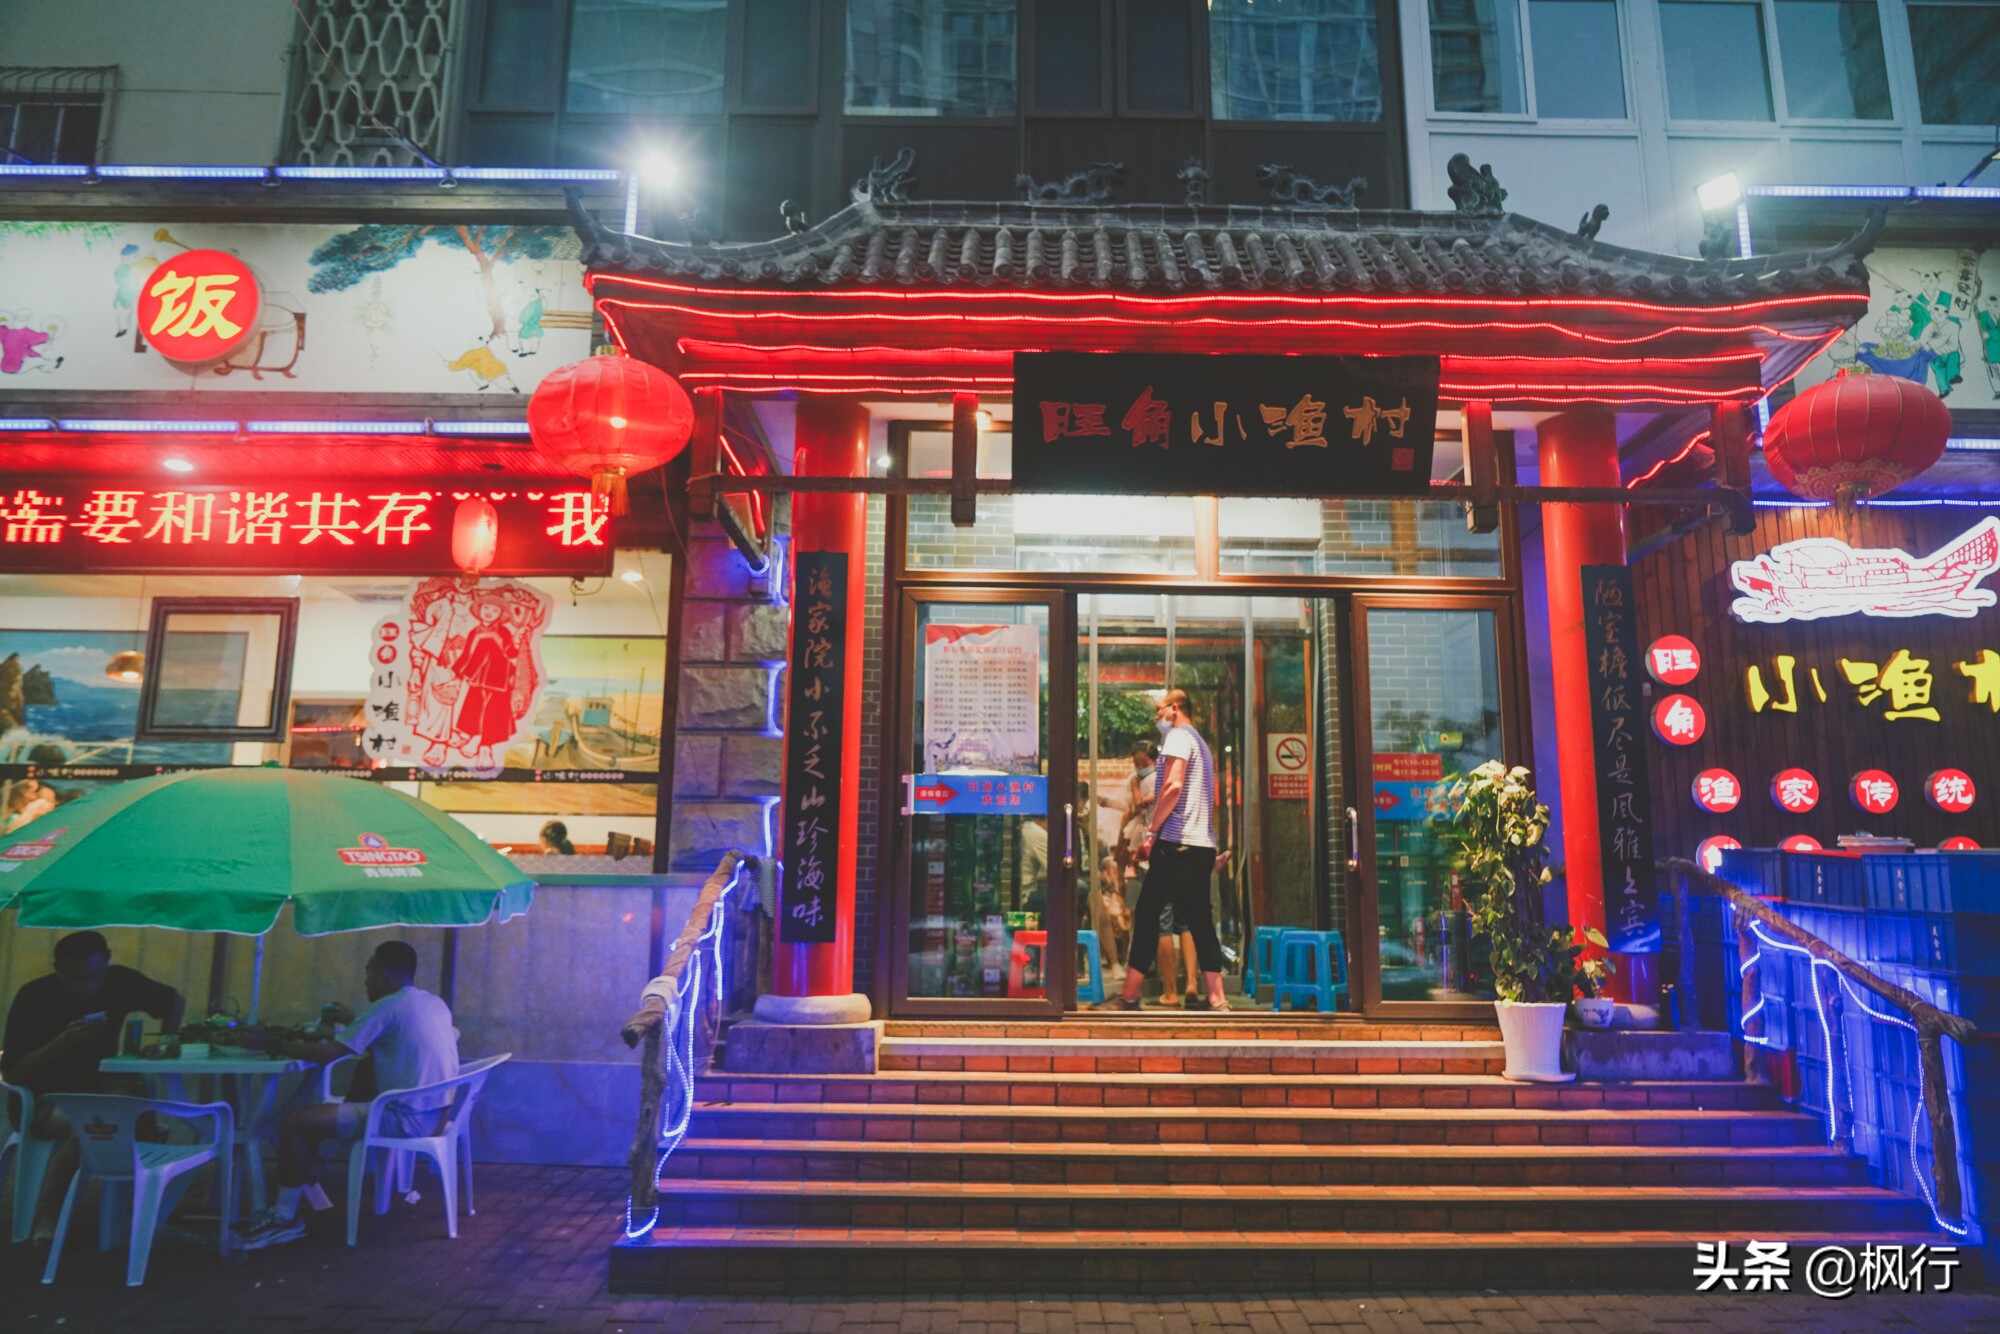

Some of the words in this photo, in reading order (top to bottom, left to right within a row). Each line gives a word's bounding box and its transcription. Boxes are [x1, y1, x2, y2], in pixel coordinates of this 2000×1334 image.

[149, 269, 243, 340] 饭
[1039, 385, 1411, 449] 旺角小渔村
[546, 491, 610, 546] 我
[1652, 647, 1699, 738] 旺角
[1700, 776, 1974, 808] 渔家传统
[344, 850, 420, 863] TSINGTAO
